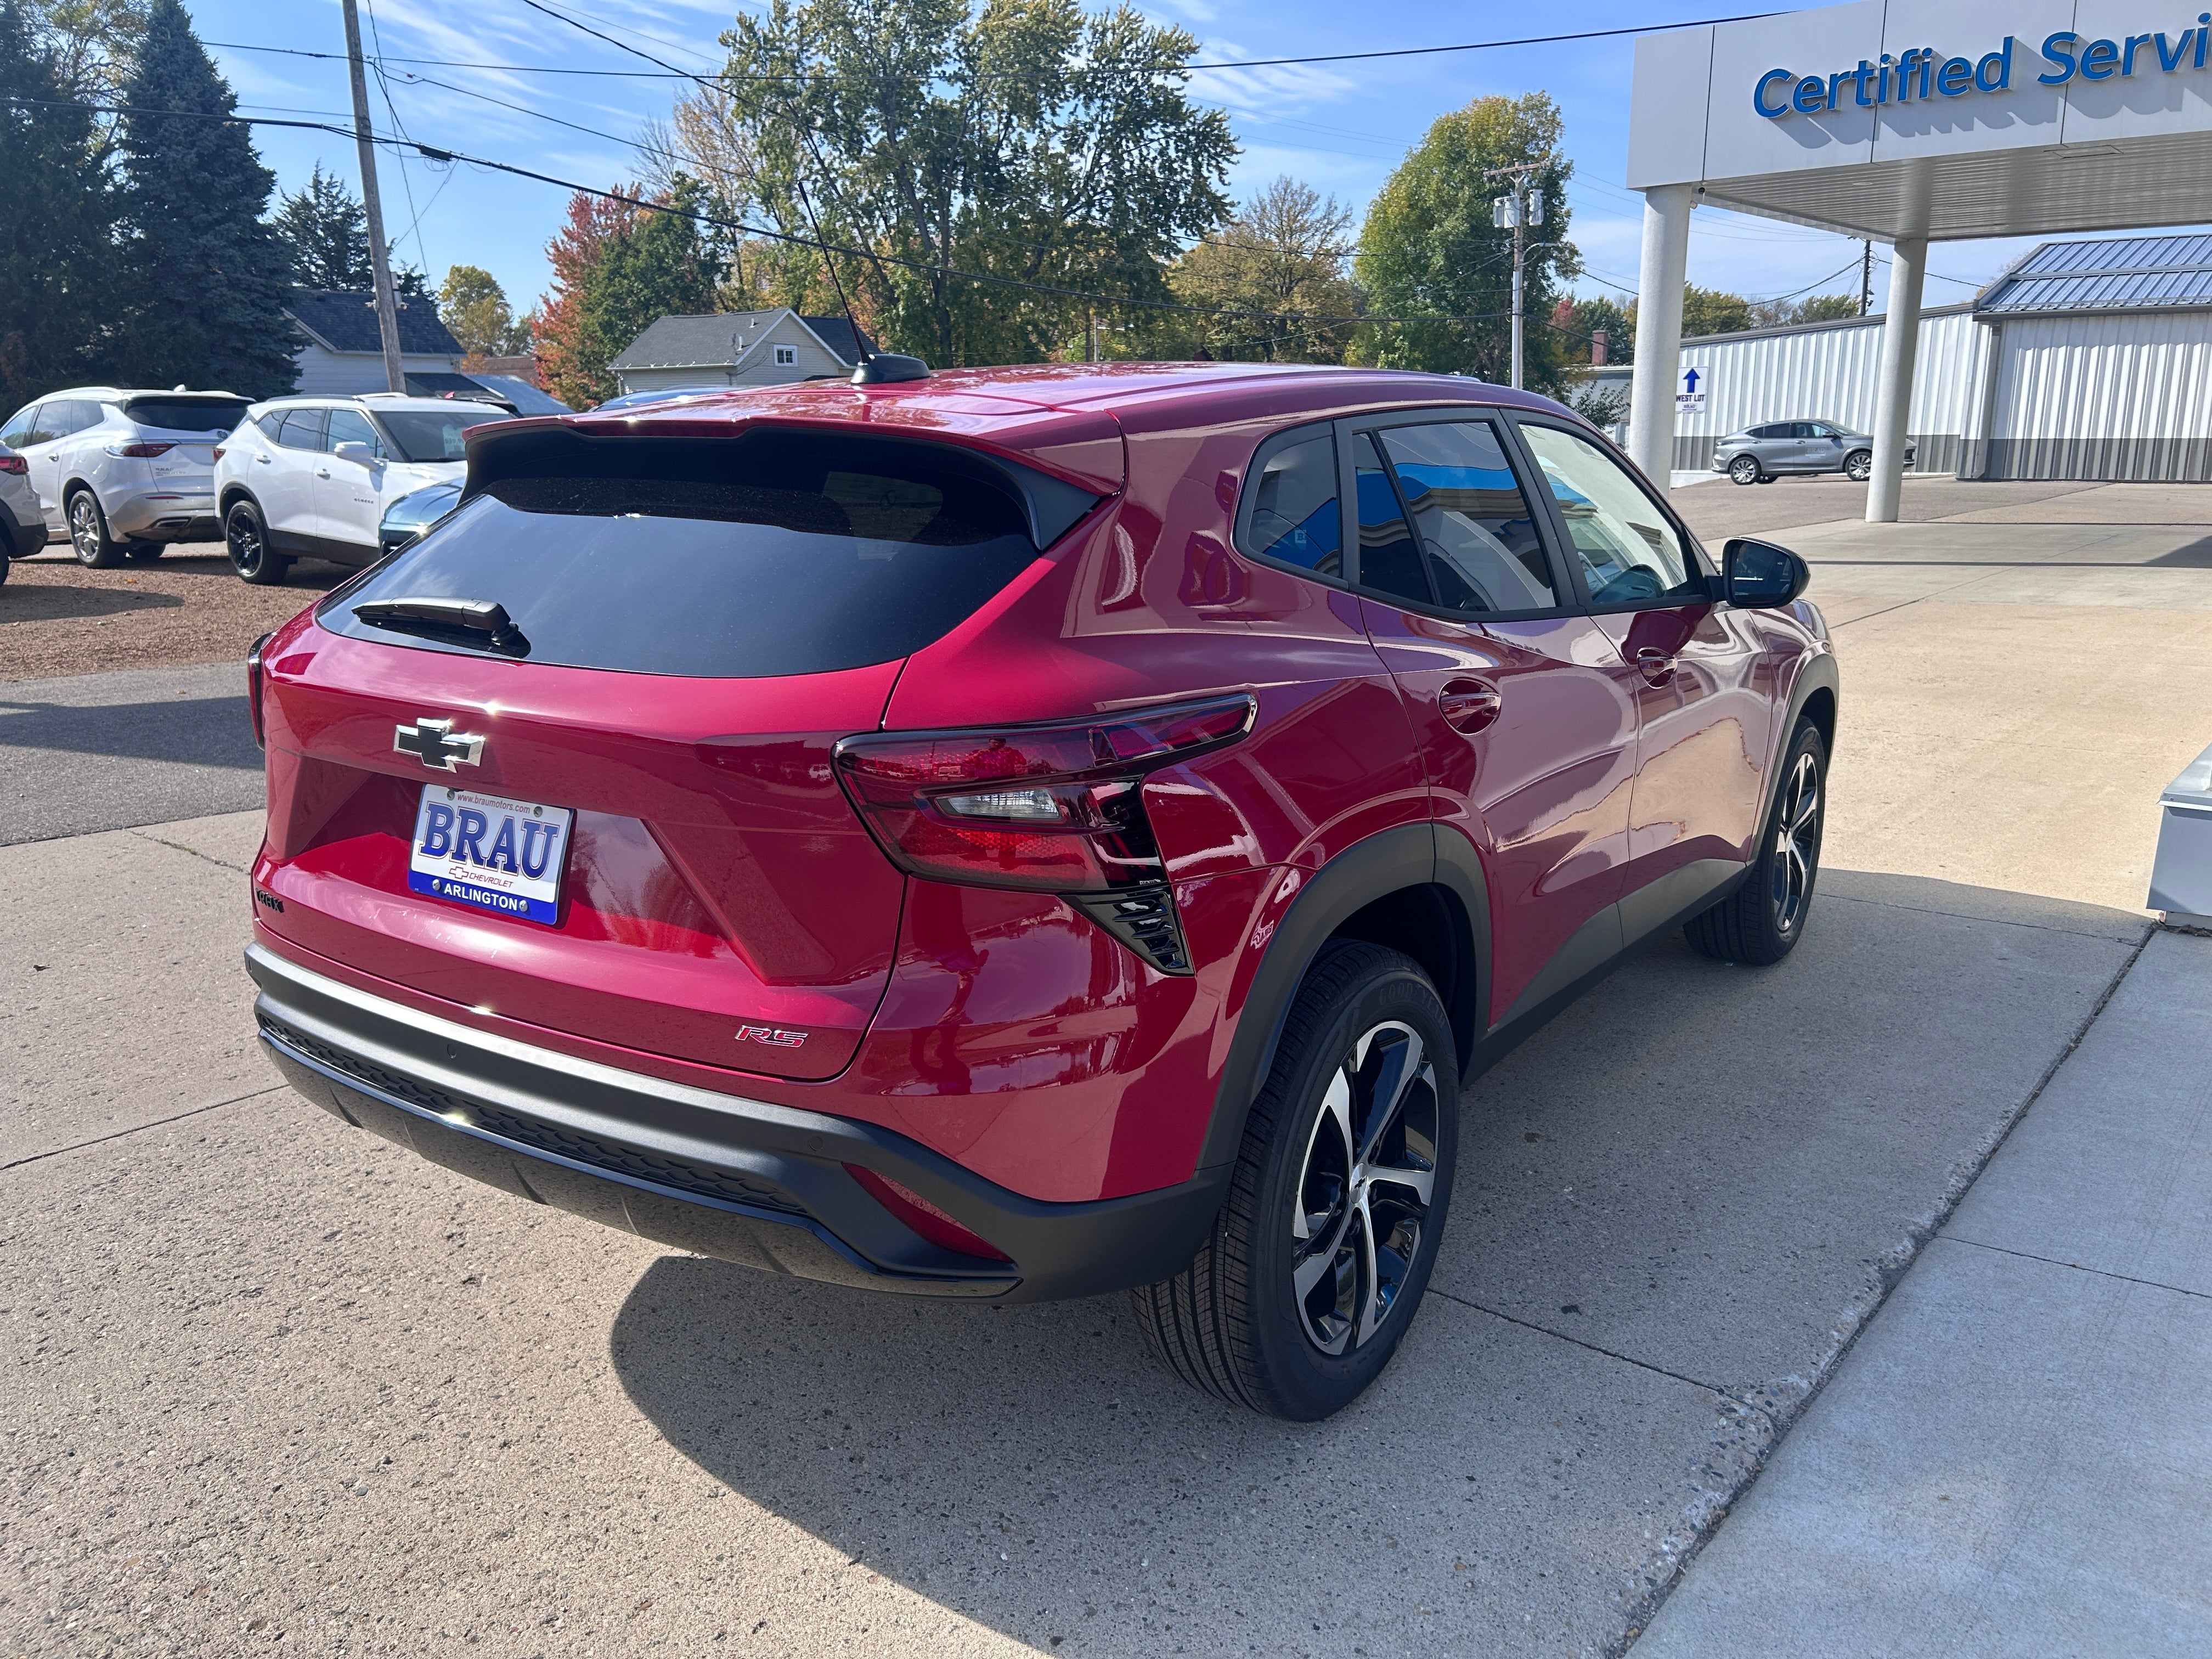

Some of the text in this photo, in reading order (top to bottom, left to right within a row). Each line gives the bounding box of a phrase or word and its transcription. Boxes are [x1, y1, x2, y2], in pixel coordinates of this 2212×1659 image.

[1753, 12, 2212, 119] Certified Servi
[458, 794, 531, 814] www.braumotors.com
[419, 800, 560, 881] BRAU
[469, 873, 514, 888] CHEVROLET
[444, 883, 517, 911] ARLINGTON
[735, 1025, 809, 1048] RS
